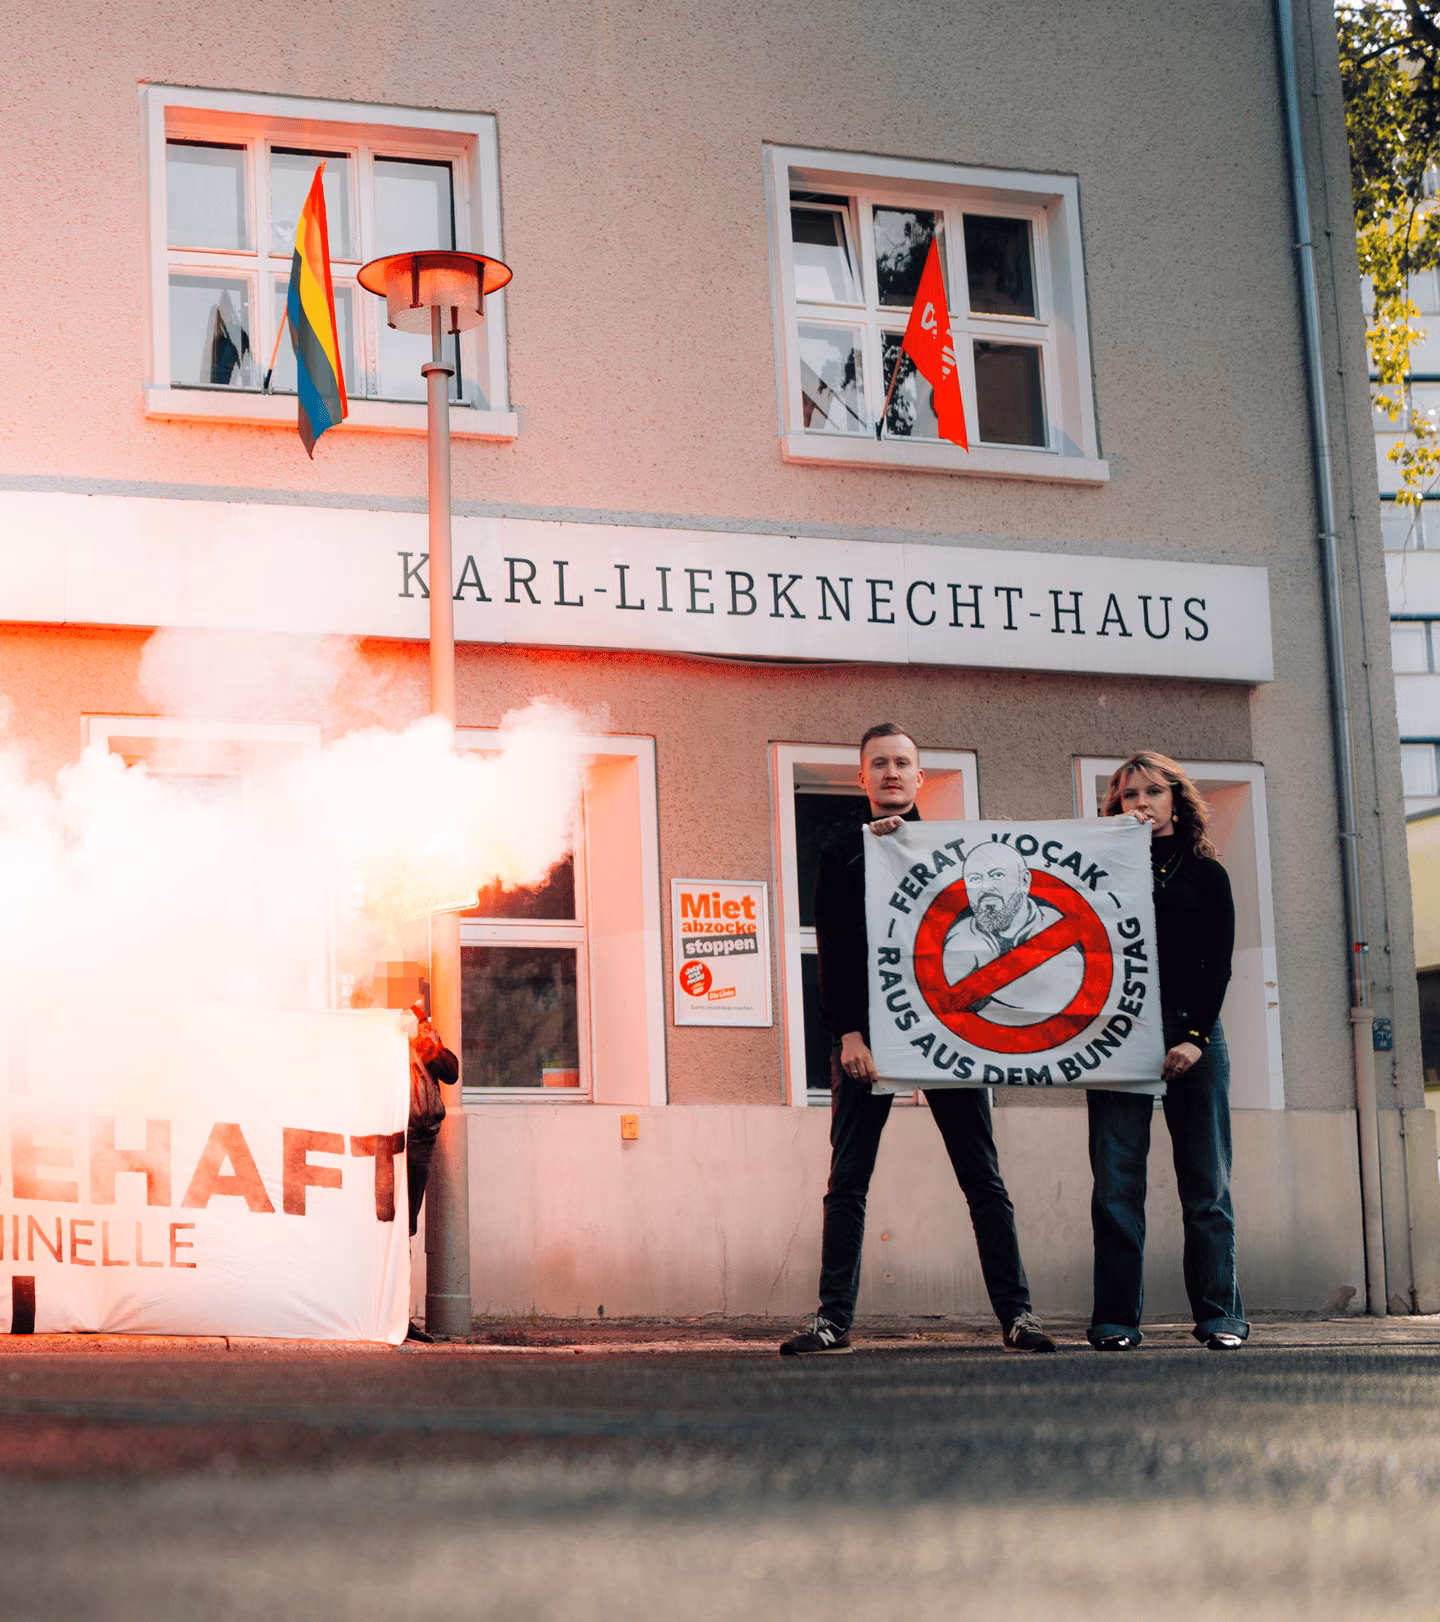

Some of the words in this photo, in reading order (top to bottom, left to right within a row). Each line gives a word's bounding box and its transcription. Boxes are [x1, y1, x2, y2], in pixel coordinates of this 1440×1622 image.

[397, 550, 1210, 643] KARL-LIEBKNECHT-HAUS
[889, 838, 967, 914] FERAT
[680, 892, 756, 920] Miet
[681, 920, 757, 934] abzocke
[685, 938, 755, 955] stoppen
[877, 946, 921, 1031] RAUS
[910, 1032, 976, 1080] AUS
[982, 1064, 1053, 1086] DEM
[1056, 917, 1149, 1082] BUNDESTAG
